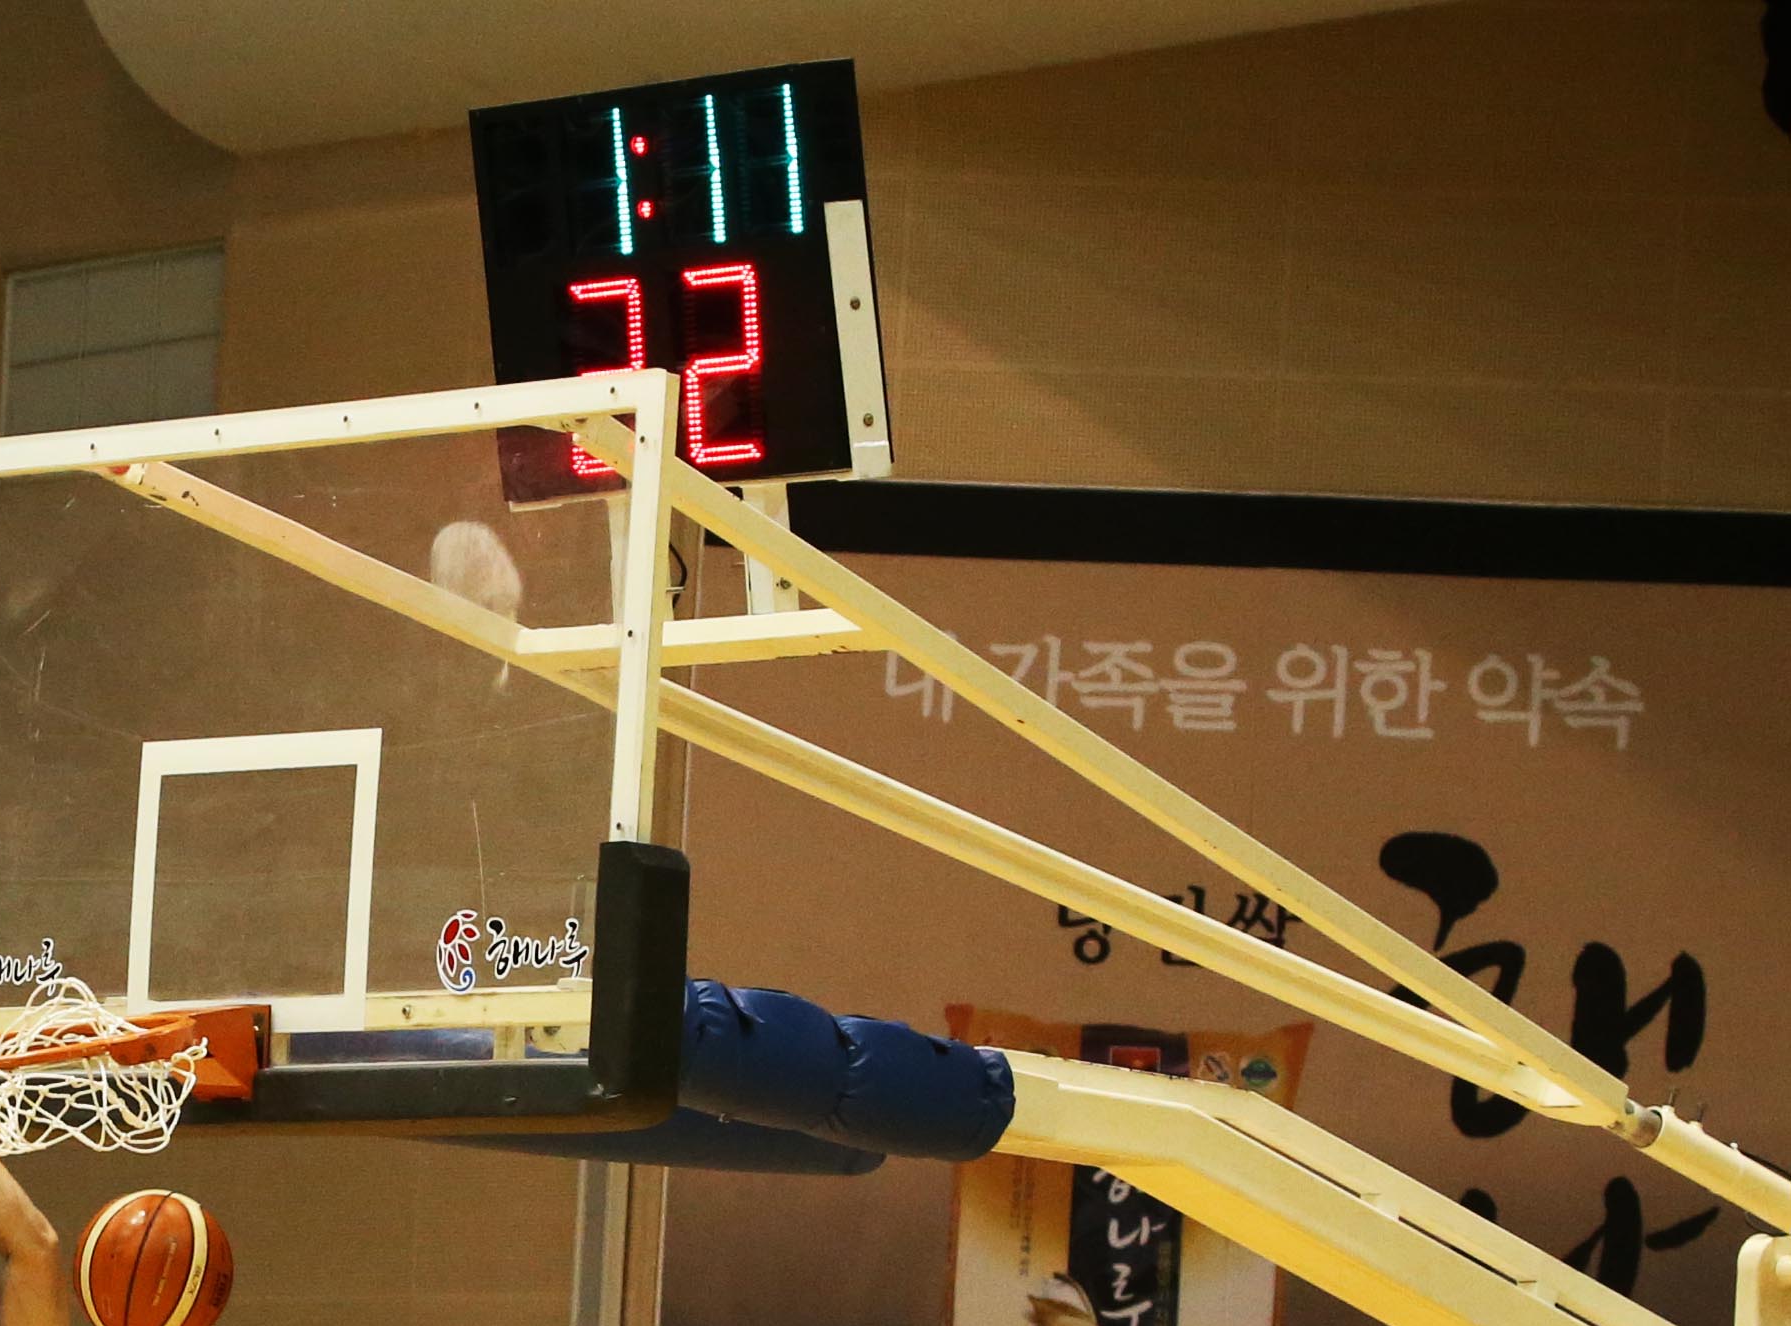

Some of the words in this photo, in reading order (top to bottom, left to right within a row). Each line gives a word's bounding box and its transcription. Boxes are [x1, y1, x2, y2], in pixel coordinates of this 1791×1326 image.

[612, 83, 806, 257] 1:11
[567, 262, 763, 477] 22
[989, 634, 1249, 733] 가족을
[1267, 642, 1447, 741] 위한
[1468, 651, 1646, 750] 약속
[485, 917, 592, 979] 해나루
